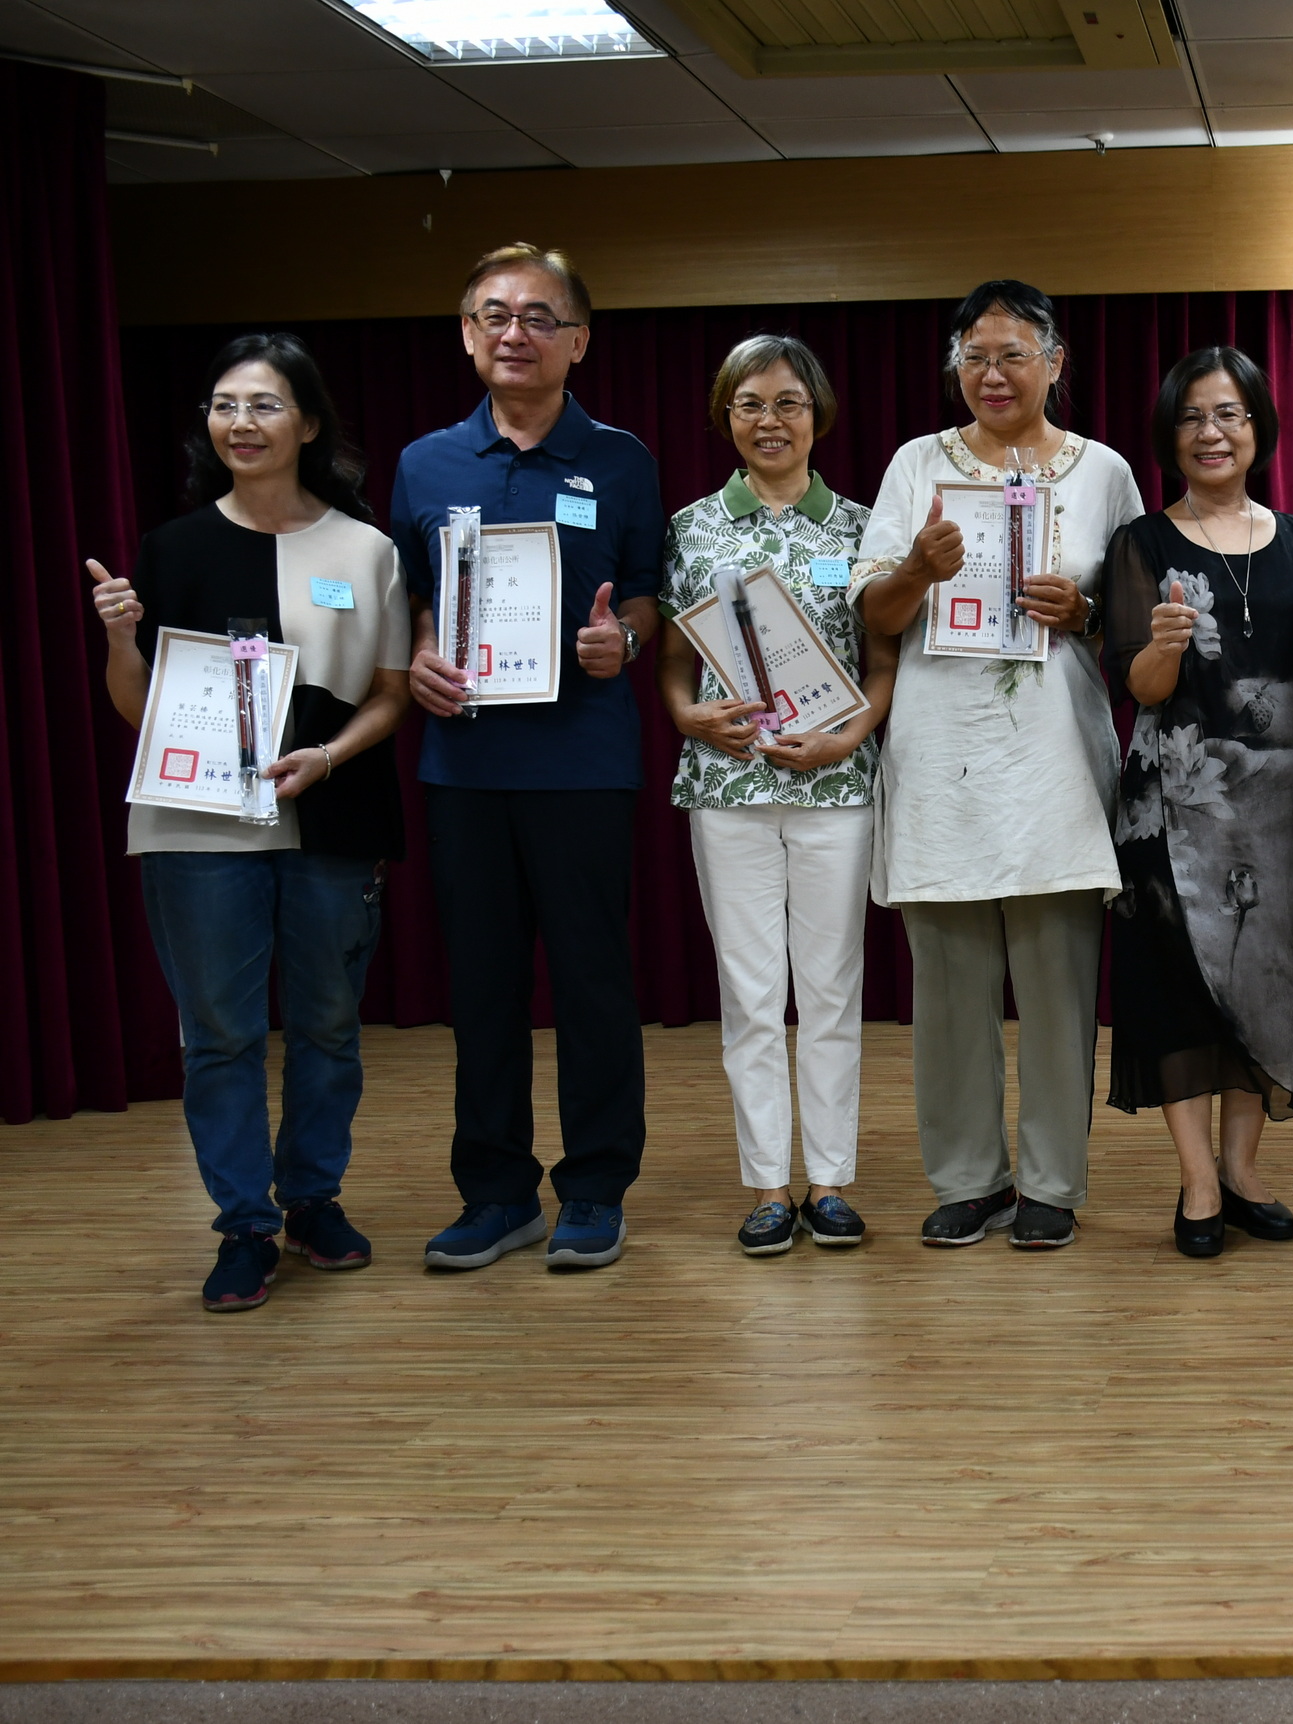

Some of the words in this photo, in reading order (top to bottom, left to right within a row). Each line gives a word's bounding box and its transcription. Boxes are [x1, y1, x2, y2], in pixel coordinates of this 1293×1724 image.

[499, 658, 538, 671] 林世賢
[799, 682, 832, 707] 林世賢
[204, 768, 240, 781] 林世
